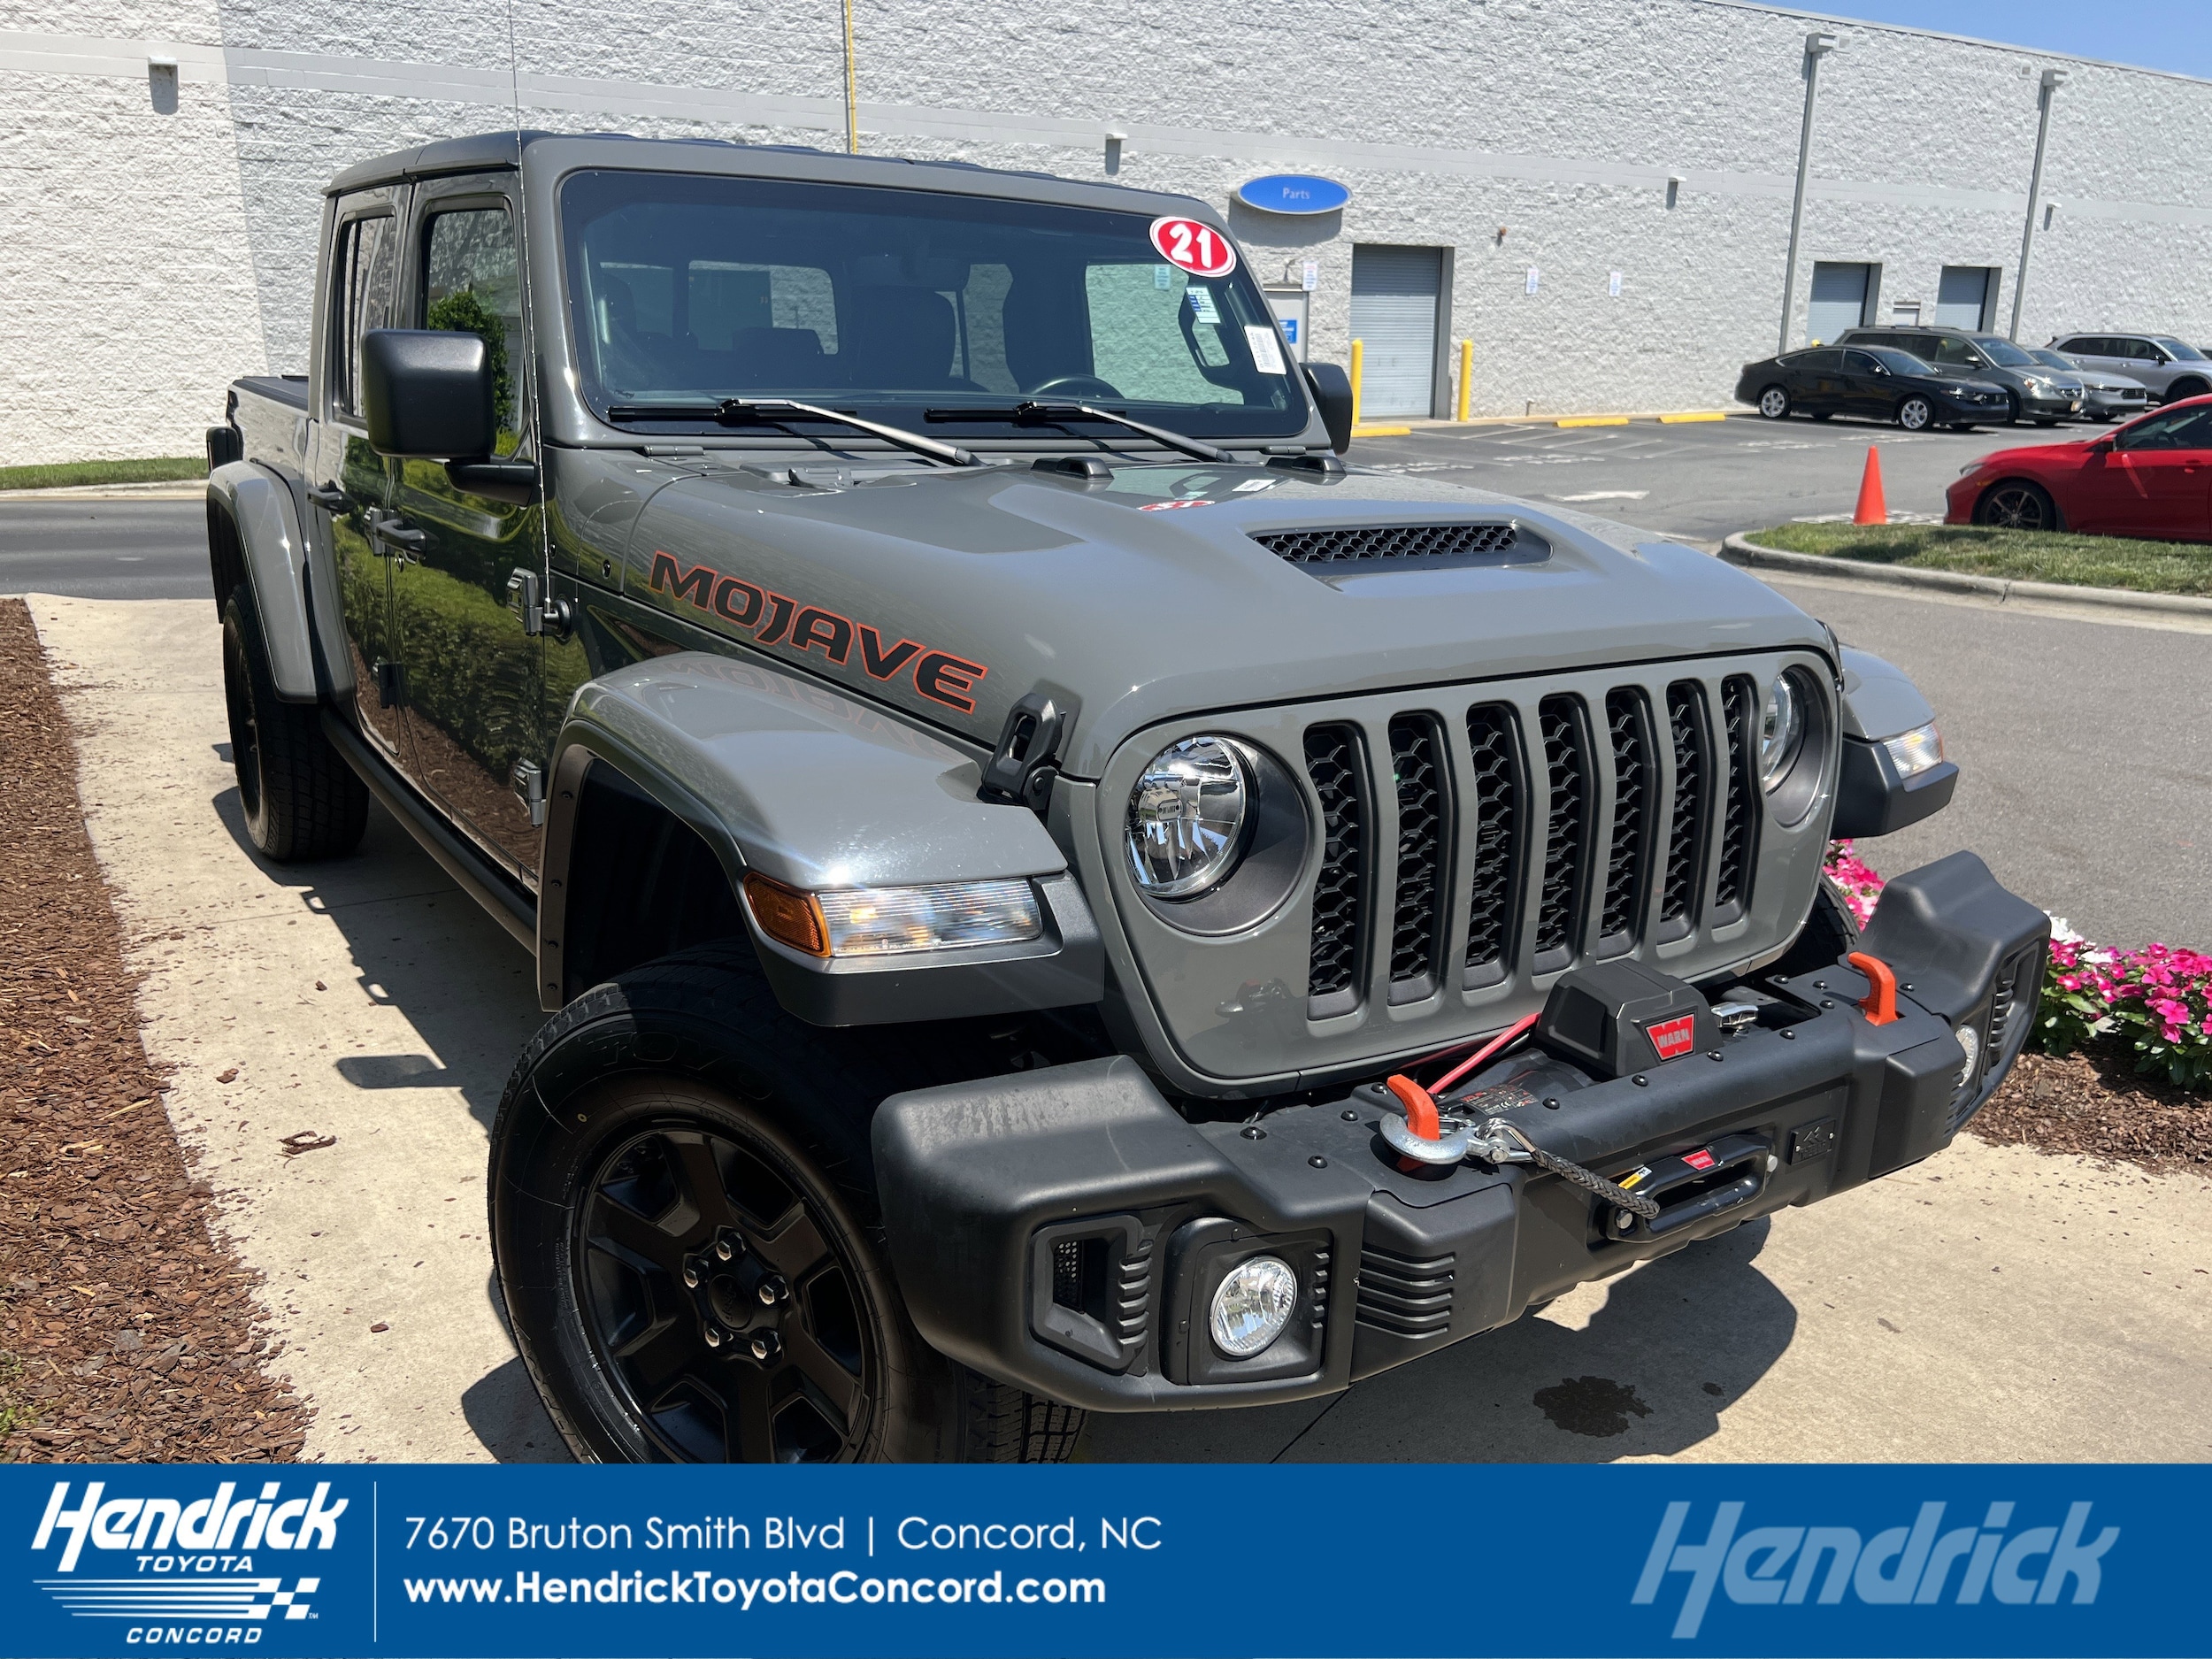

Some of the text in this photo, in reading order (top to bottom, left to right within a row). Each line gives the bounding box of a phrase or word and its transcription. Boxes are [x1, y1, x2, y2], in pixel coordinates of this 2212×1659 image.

[1282, 187, 1310, 200] Parts
[1169, 223, 1212, 269] 21
[649, 549, 988, 715] MOJAVE
[1656, 1027, 1691, 1049] WARN
